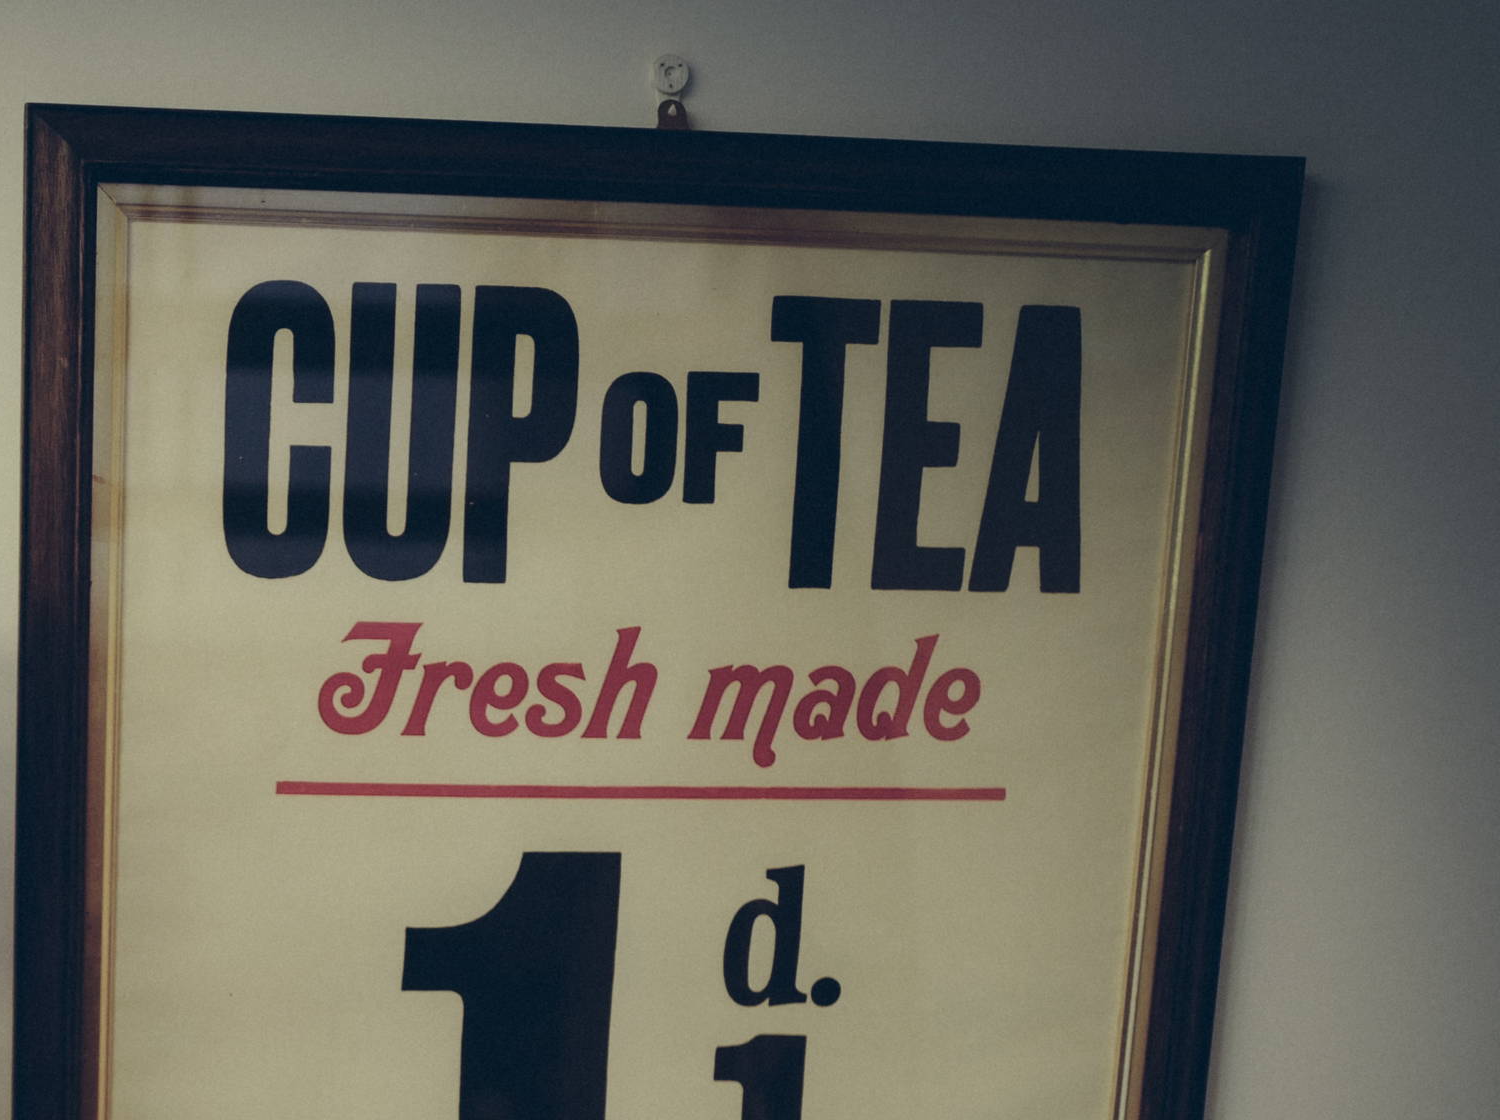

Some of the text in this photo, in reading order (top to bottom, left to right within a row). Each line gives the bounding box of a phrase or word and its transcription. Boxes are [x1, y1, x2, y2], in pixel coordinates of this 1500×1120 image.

[222, 279, 1083, 595] CUP OF TEA
[318, 621, 982, 769] Fresh made
[723, 865, 841, 1007] d.
